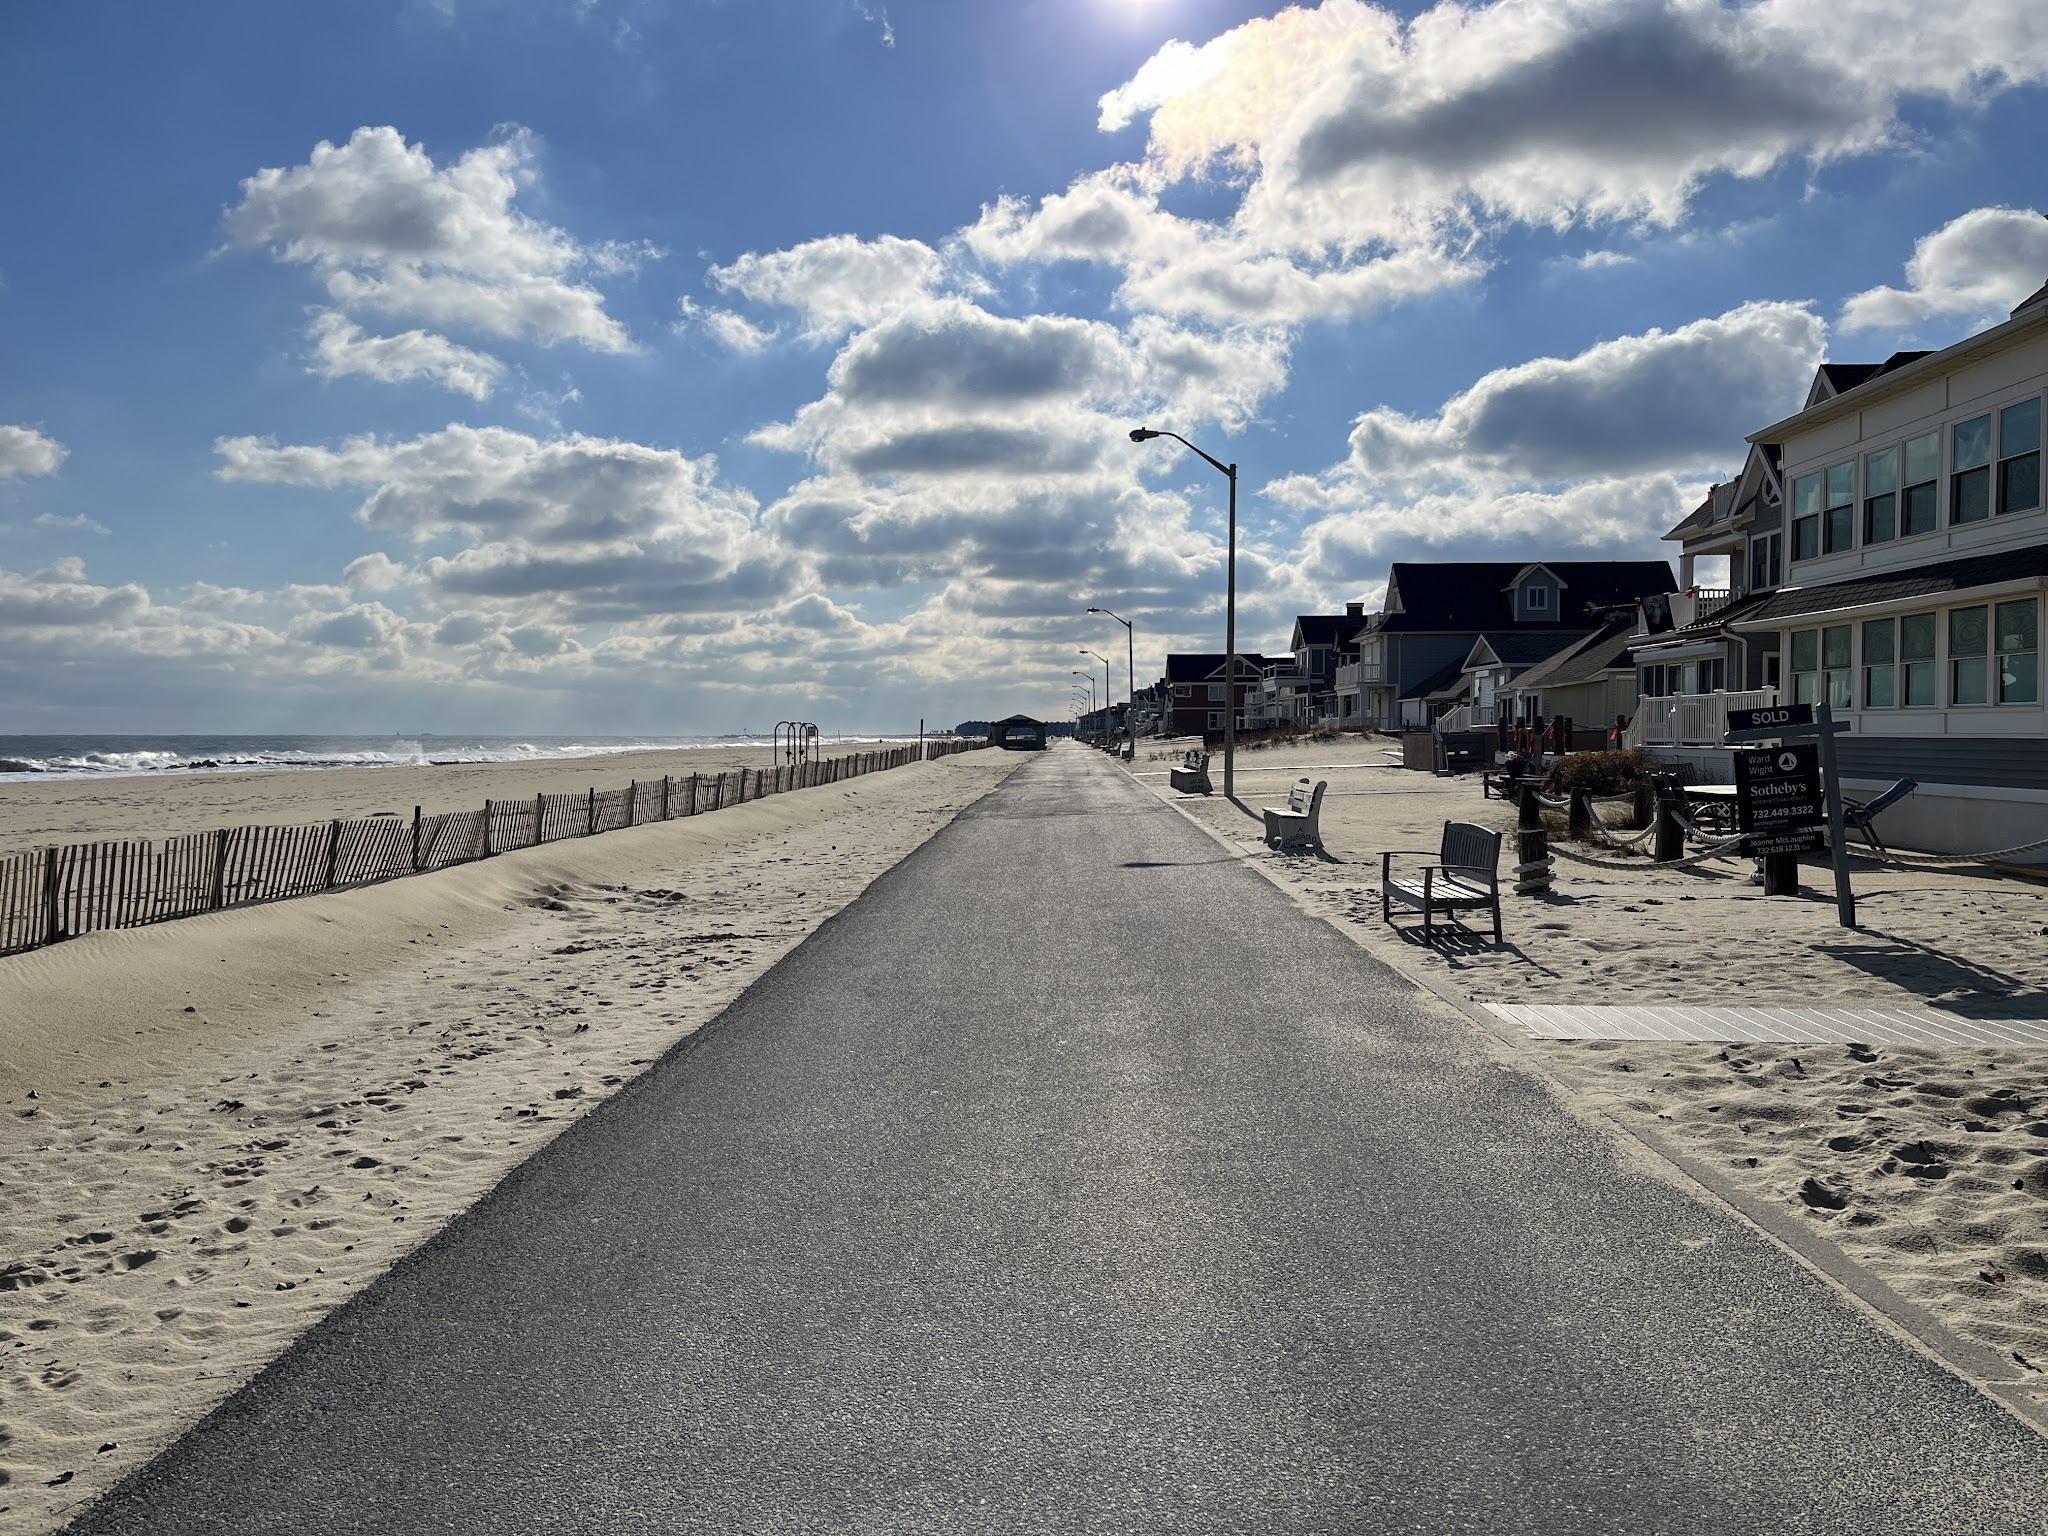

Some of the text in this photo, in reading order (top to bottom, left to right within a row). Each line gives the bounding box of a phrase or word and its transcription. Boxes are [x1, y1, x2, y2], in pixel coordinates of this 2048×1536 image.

[1752, 710, 1789, 725] SOLD
[1748, 754, 1770, 764] Ward
[1749, 765, 1773, 776] Wight
[1750, 781, 1807, 797] Sotheby's
[1752, 805, 1814, 820] 732.449.3322
[1750, 834, 1816, 847] Joanne McLaughlin
